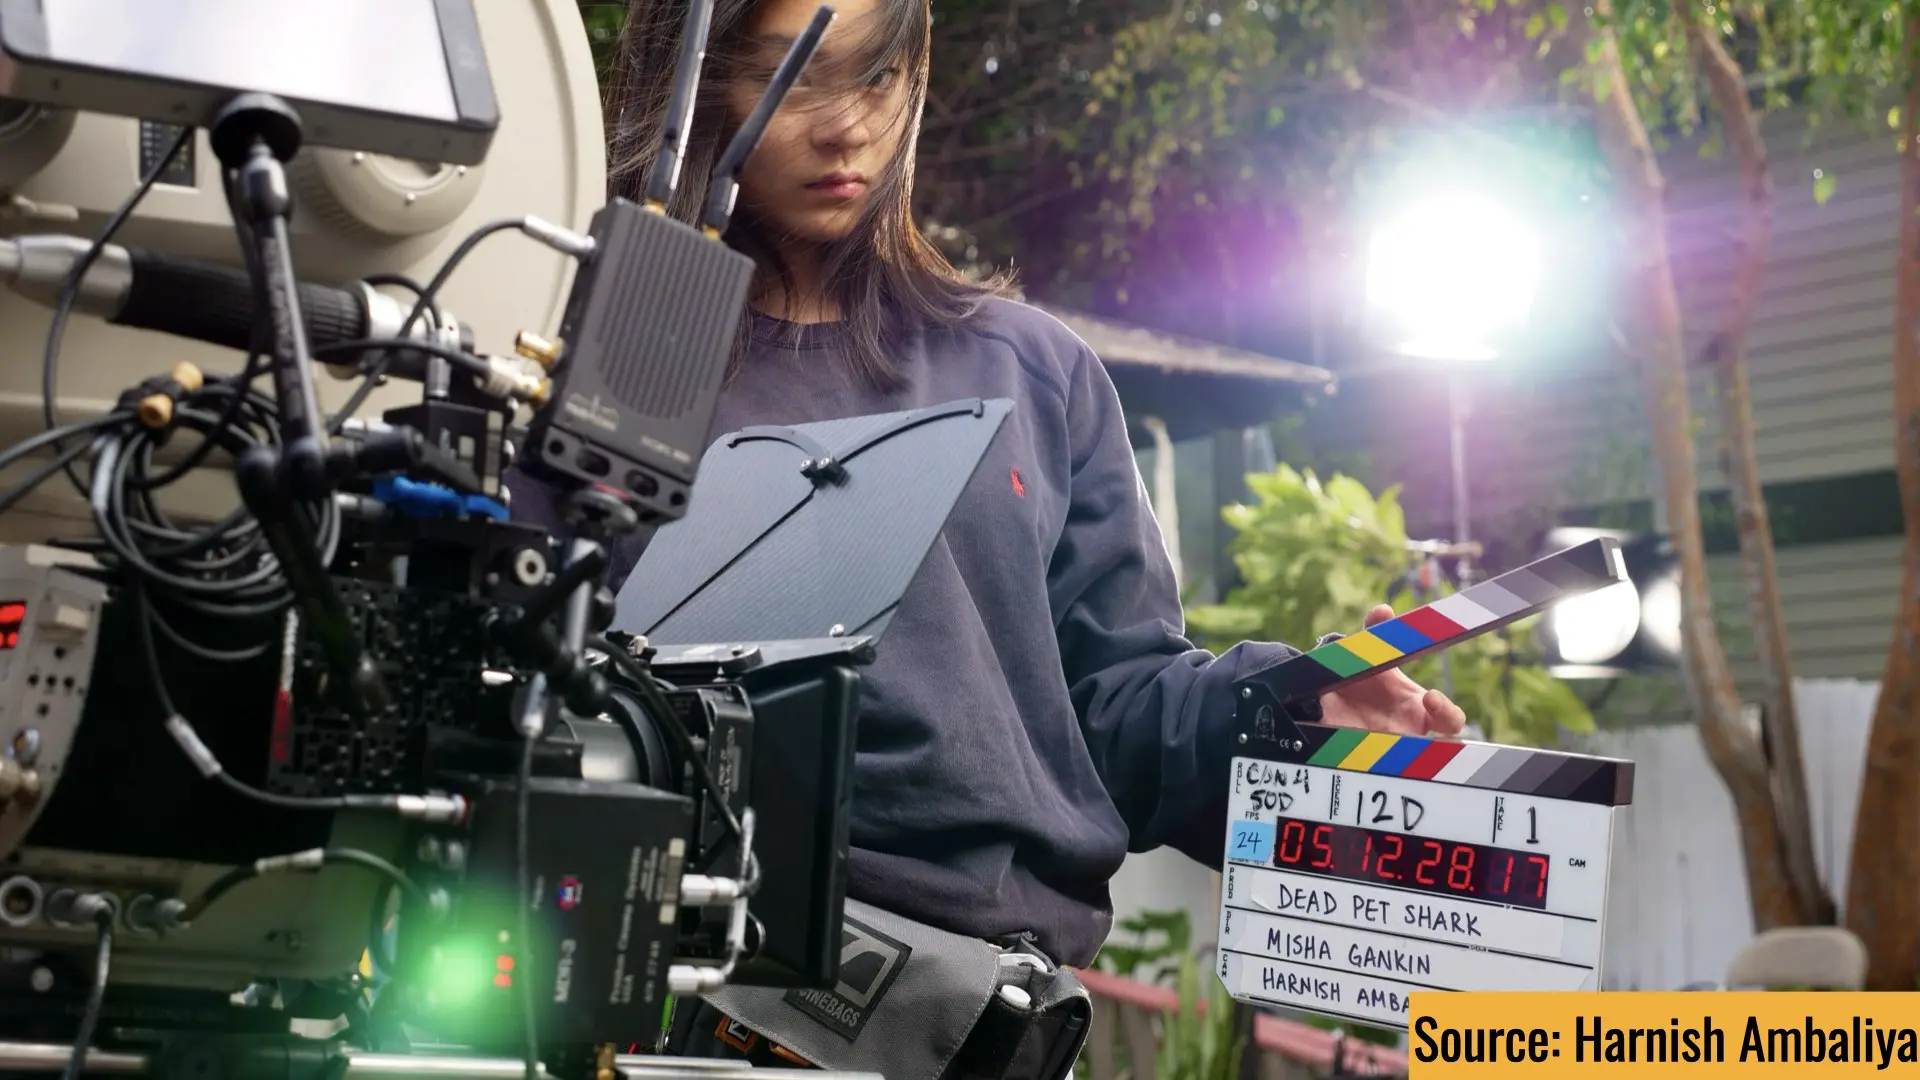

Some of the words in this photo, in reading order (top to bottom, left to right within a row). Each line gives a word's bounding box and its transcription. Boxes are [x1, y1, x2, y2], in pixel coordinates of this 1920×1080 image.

[1334, 775, 1342, 816] SCENE
[1356, 790, 1425, 831] 12D
[1245, 811, 1260, 821] FPS
[1497, 797, 1505, 831] TAKE
[1526, 806, 1539, 844] 1
[1237, 832, 1263, 854] 24
[1569, 858, 1586, 868] CAM
[1277, 883, 1337, 915] DEAD
[1352, 895, 1390, 924] PET
[1404, 905, 1482, 937] SHARK
[1267, 928, 1332, 960] MISHA
[1348, 944, 1430, 975] GANKIN
[1263, 967, 1341, 1002] HARNISH
